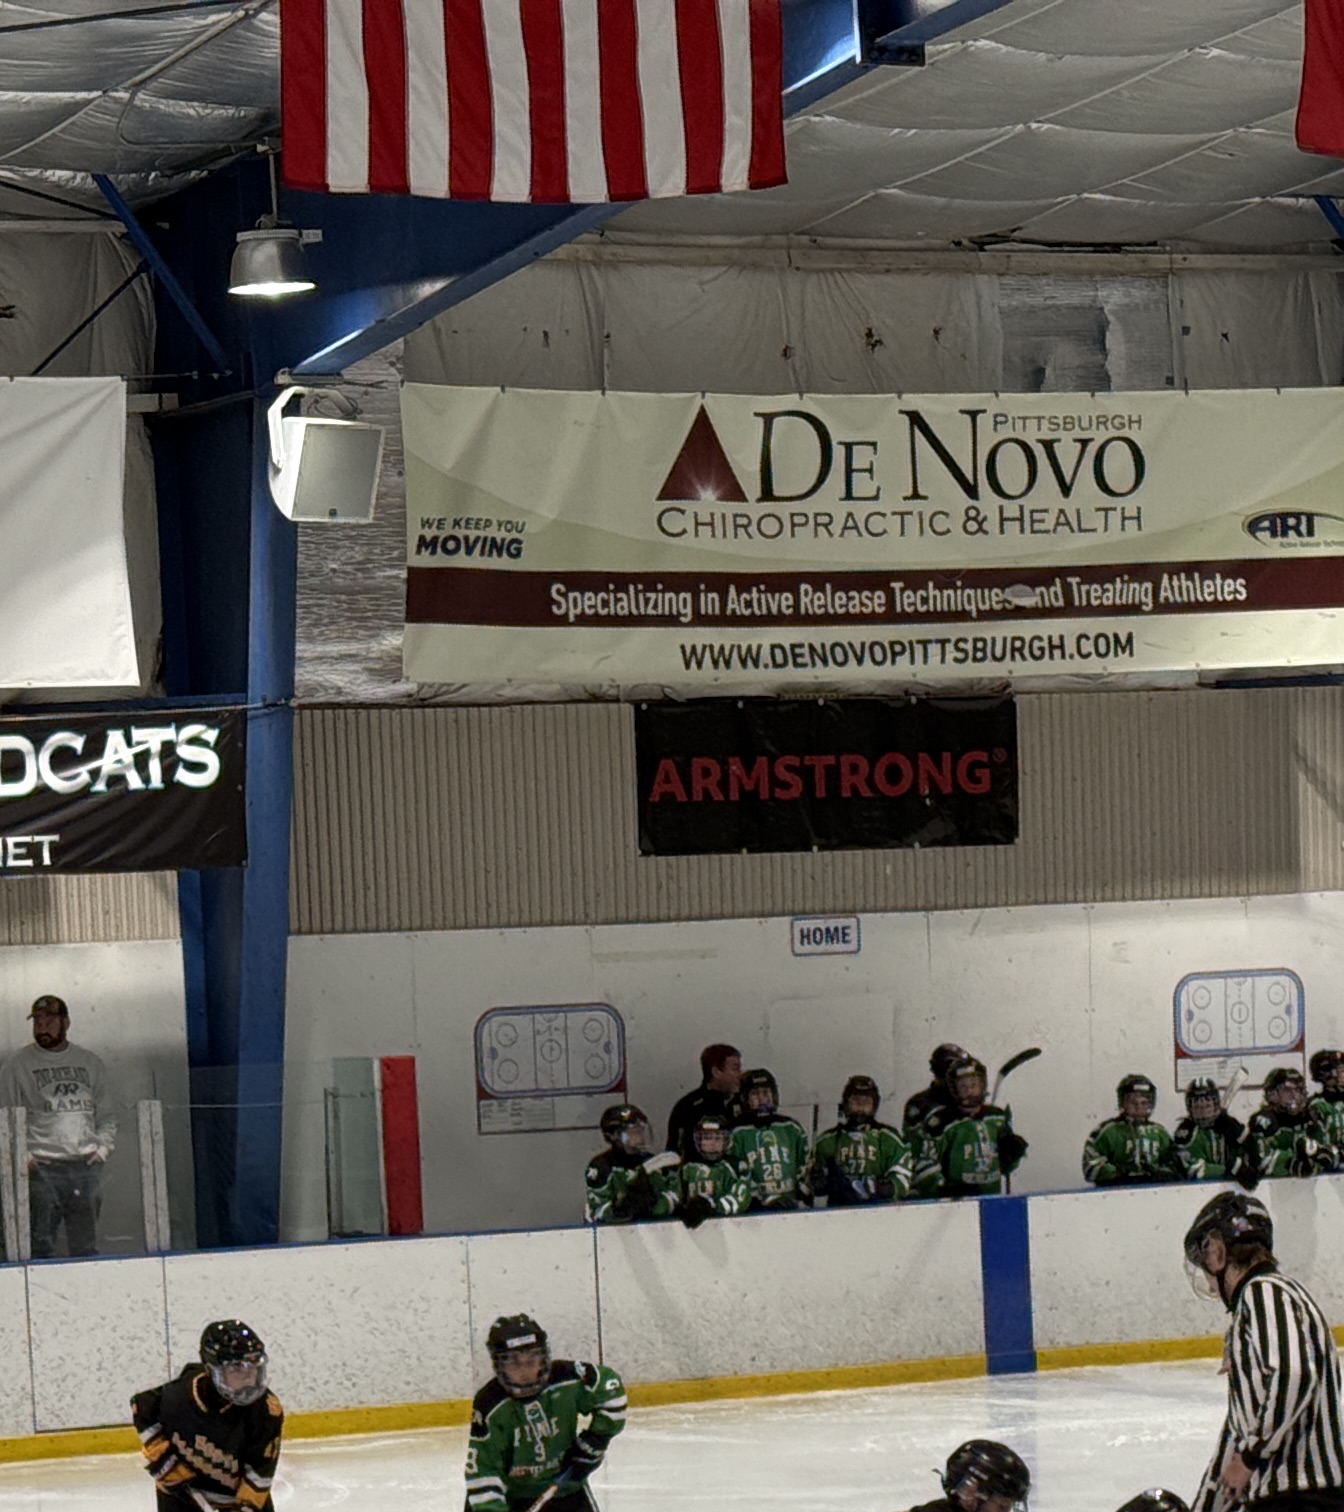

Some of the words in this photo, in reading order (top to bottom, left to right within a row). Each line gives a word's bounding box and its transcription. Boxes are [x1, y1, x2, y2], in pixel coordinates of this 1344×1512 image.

[993, 413, 1143, 433] PITTSBURGH
[420, 517, 447, 531] WE
[452, 517, 493, 531] KEEP
[496, 519, 526, 534] YOU
[415, 534, 524, 559] MOVING
[550, 582, 693, 624] Specializing
[701, 584, 720, 616] in
[725, 584, 794, 616] Active
[800, 583, 887, 614] Release
[1067, 576, 1154, 611] Treating
[1159, 571, 1248, 602] Athletes
[680, 631, 1135, 672] WWW.DENOVOPITTSBURGH.COM
[799, 925, 853, 947] HOME
